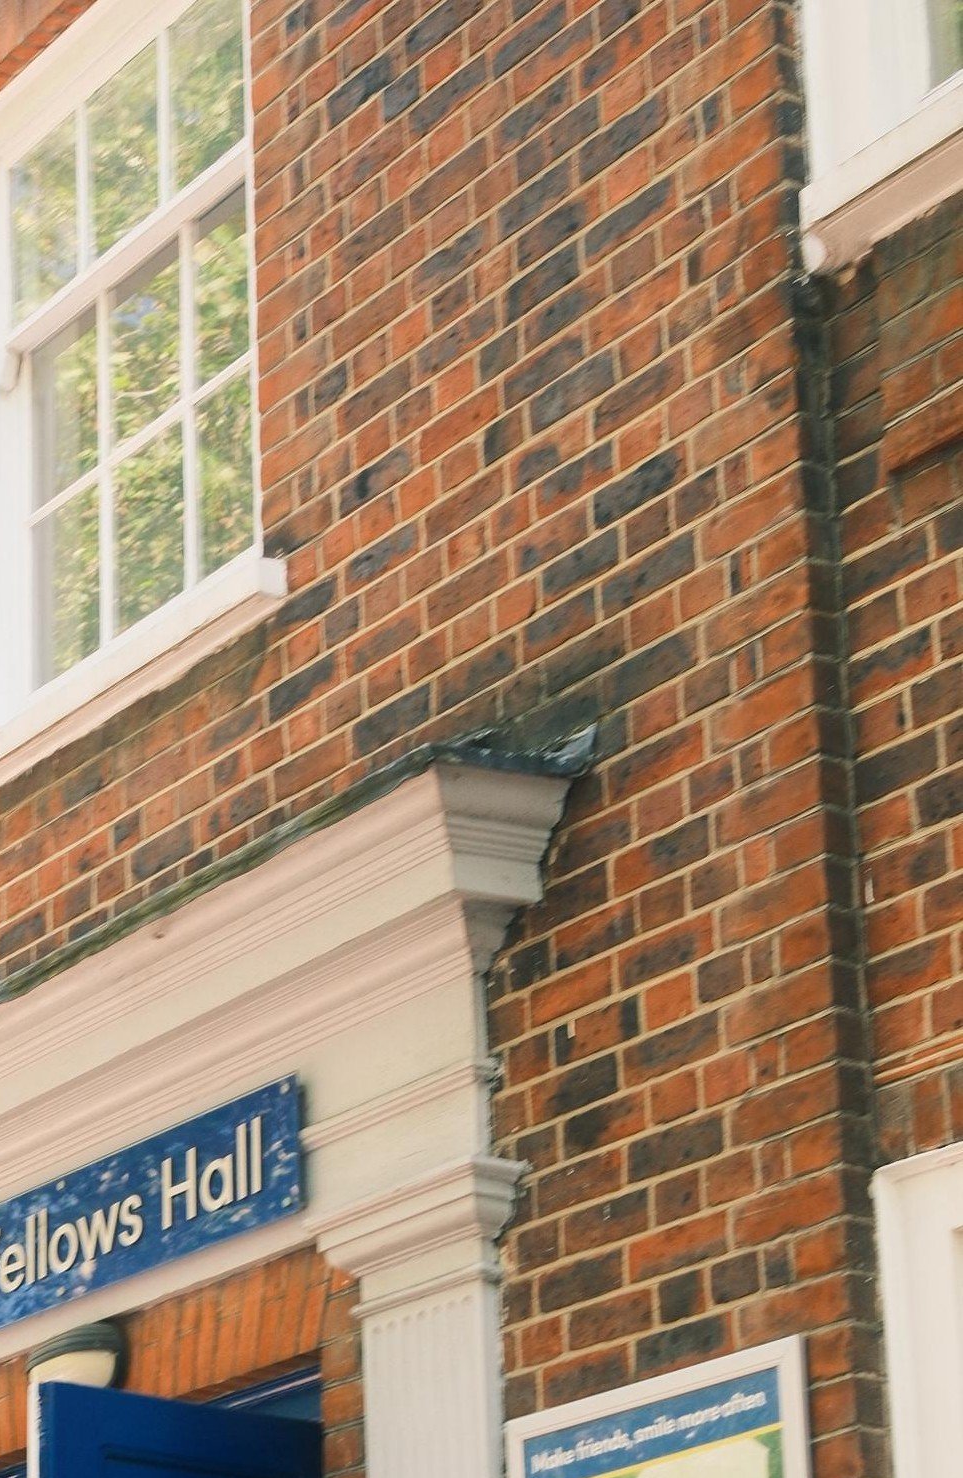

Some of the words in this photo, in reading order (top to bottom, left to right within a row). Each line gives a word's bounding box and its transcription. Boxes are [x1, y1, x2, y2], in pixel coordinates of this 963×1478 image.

[161, 1116, 262, 1230] Hall
[531, 1447, 575, 1474] Make
[575, 1429, 634, 1461] friends,
[633, 1416, 677, 1443] smile
[677, 1405, 721, 1430] more
[721, 1392, 767, 1417] often
